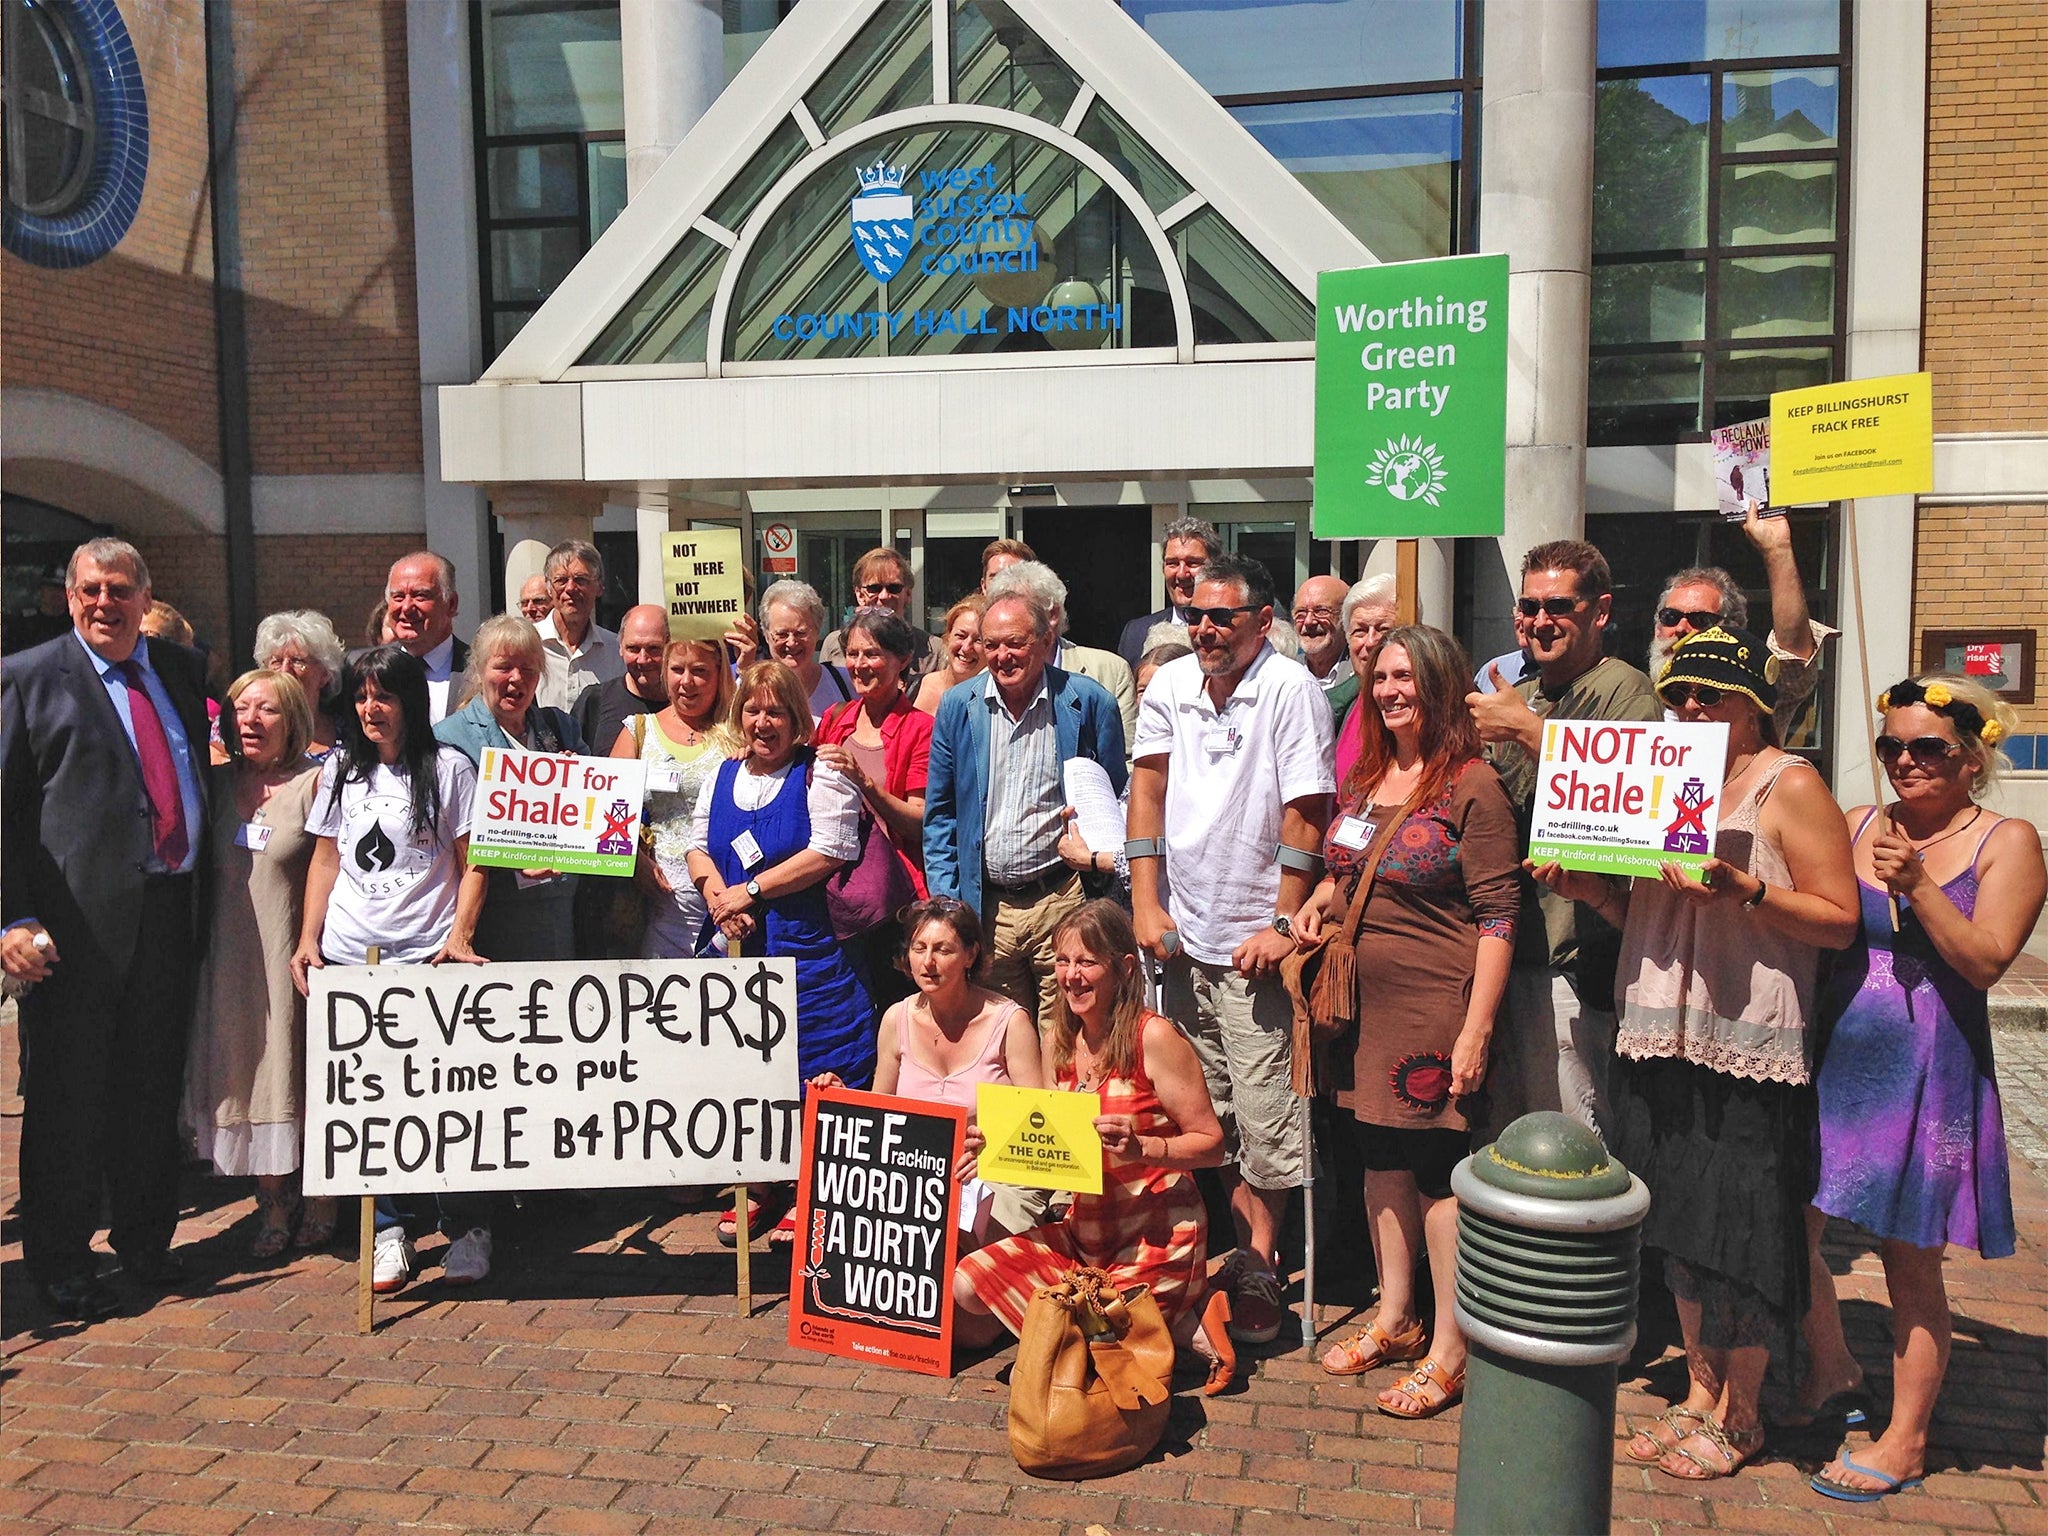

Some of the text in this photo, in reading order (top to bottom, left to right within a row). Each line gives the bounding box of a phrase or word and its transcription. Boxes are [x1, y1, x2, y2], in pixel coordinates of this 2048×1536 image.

[919, 162, 998, 192] west
[919, 192, 1028, 219] sussex
[919, 218, 1035, 251] county
[919, 242, 1038, 277] council
[772, 303, 1123, 342] COUNTY HALL NORTH
[1334, 295, 1487, 333] Worthing
[1361, 343, 1456, 371] Green
[1366, 379, 1450, 417] Party
[1787, 393, 1910, 419] KEEP BILLINGSHURST
[1721, 421, 1766, 444] RECLAIM
[1811, 416, 1880, 434] FRACK FREE
[1740, 434, 1770, 453] POWE
[1843, 448, 1877, 457] FACEBOOK
[672, 543, 697, 558] NOT
[693, 561, 724, 576] HERE
[675, 582, 700, 596] NOT
[671, 599, 738, 615] ANYWHERE
[1967, 644, 1984, 656] Dry
[1967, 653, 1989, 662] riser
[1650, 736, 1692, 767] for
[583, 767, 618, 791] for
[488, 828, 558, 841] no-drilling.co.uk
[1548, 820, 1619, 833] no-drilling.co.uk
[1547, 832, 1650, 845] facebook.com/NoDrillingSussex
[472, 849, 500, 858] KEEP
[502, 850, 537, 863] Kirdford
[538, 853, 554, 863] and
[555, 856, 602, 868] Wisborough
[1534, 847, 1559, 857] KEEP
[1561, 850, 1596, 861] Kirdford
[1597, 853, 1614, 863] and
[327, 1050, 638, 1105] It's time to put
[325, 1098, 800, 1180] PEOPLE B4 PROFIT
[817, 1112, 874, 1162] THE
[1021, 1132, 1055, 1145] LOCK
[1008, 1145, 1070, 1161] THE GATE
[816, 1160, 908, 1215] WORD
[913, 1175, 946, 1222] IS
[826, 1211, 942, 1272] A DIRTY
[843, 1262, 938, 1320] WORD
[852, 1341, 865, 1351] Take
[865, 1344, 882, 1355] action
